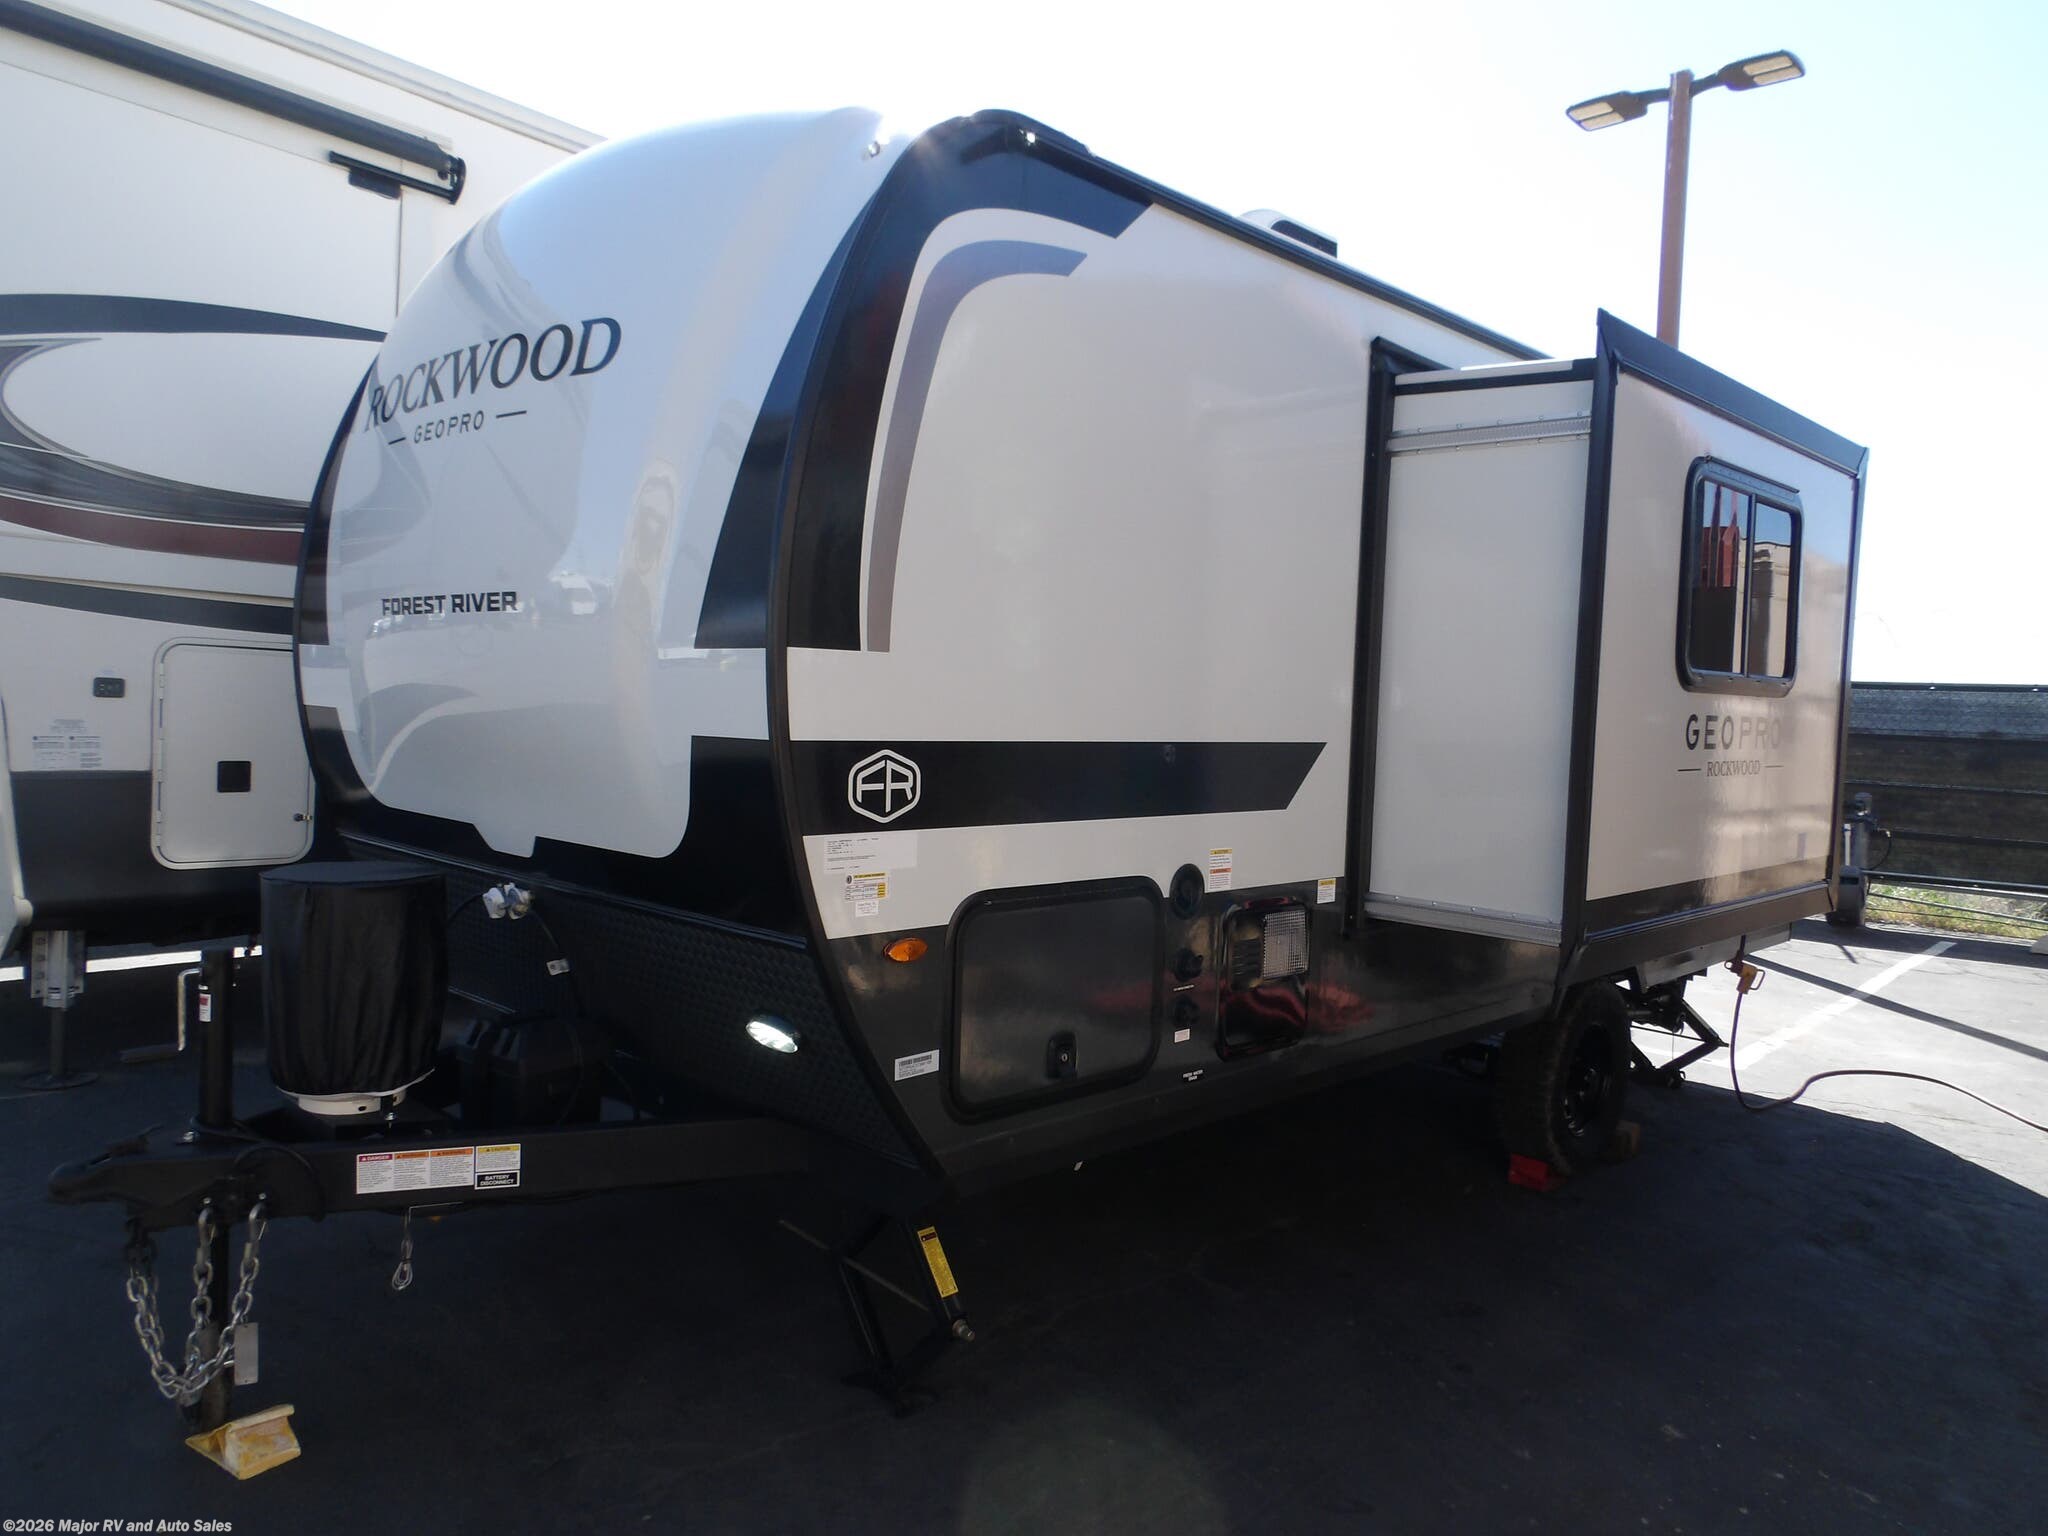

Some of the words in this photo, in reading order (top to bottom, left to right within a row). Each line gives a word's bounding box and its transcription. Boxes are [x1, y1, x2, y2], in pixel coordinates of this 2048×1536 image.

[364, 317, 622, 433] ROCKWOOD
[413, 410, 485, 444] GEOPRO
[381, 595, 446, 616] FOREST
[451, 592, 518, 613] RIVER
[1686, 714, 1780, 750] GEOPRO
[1706, 760, 1760, 777] ROCKWOOD
[856, 760, 914, 813] FR
[480, 1178, 515, 1186] DISCONNECT
